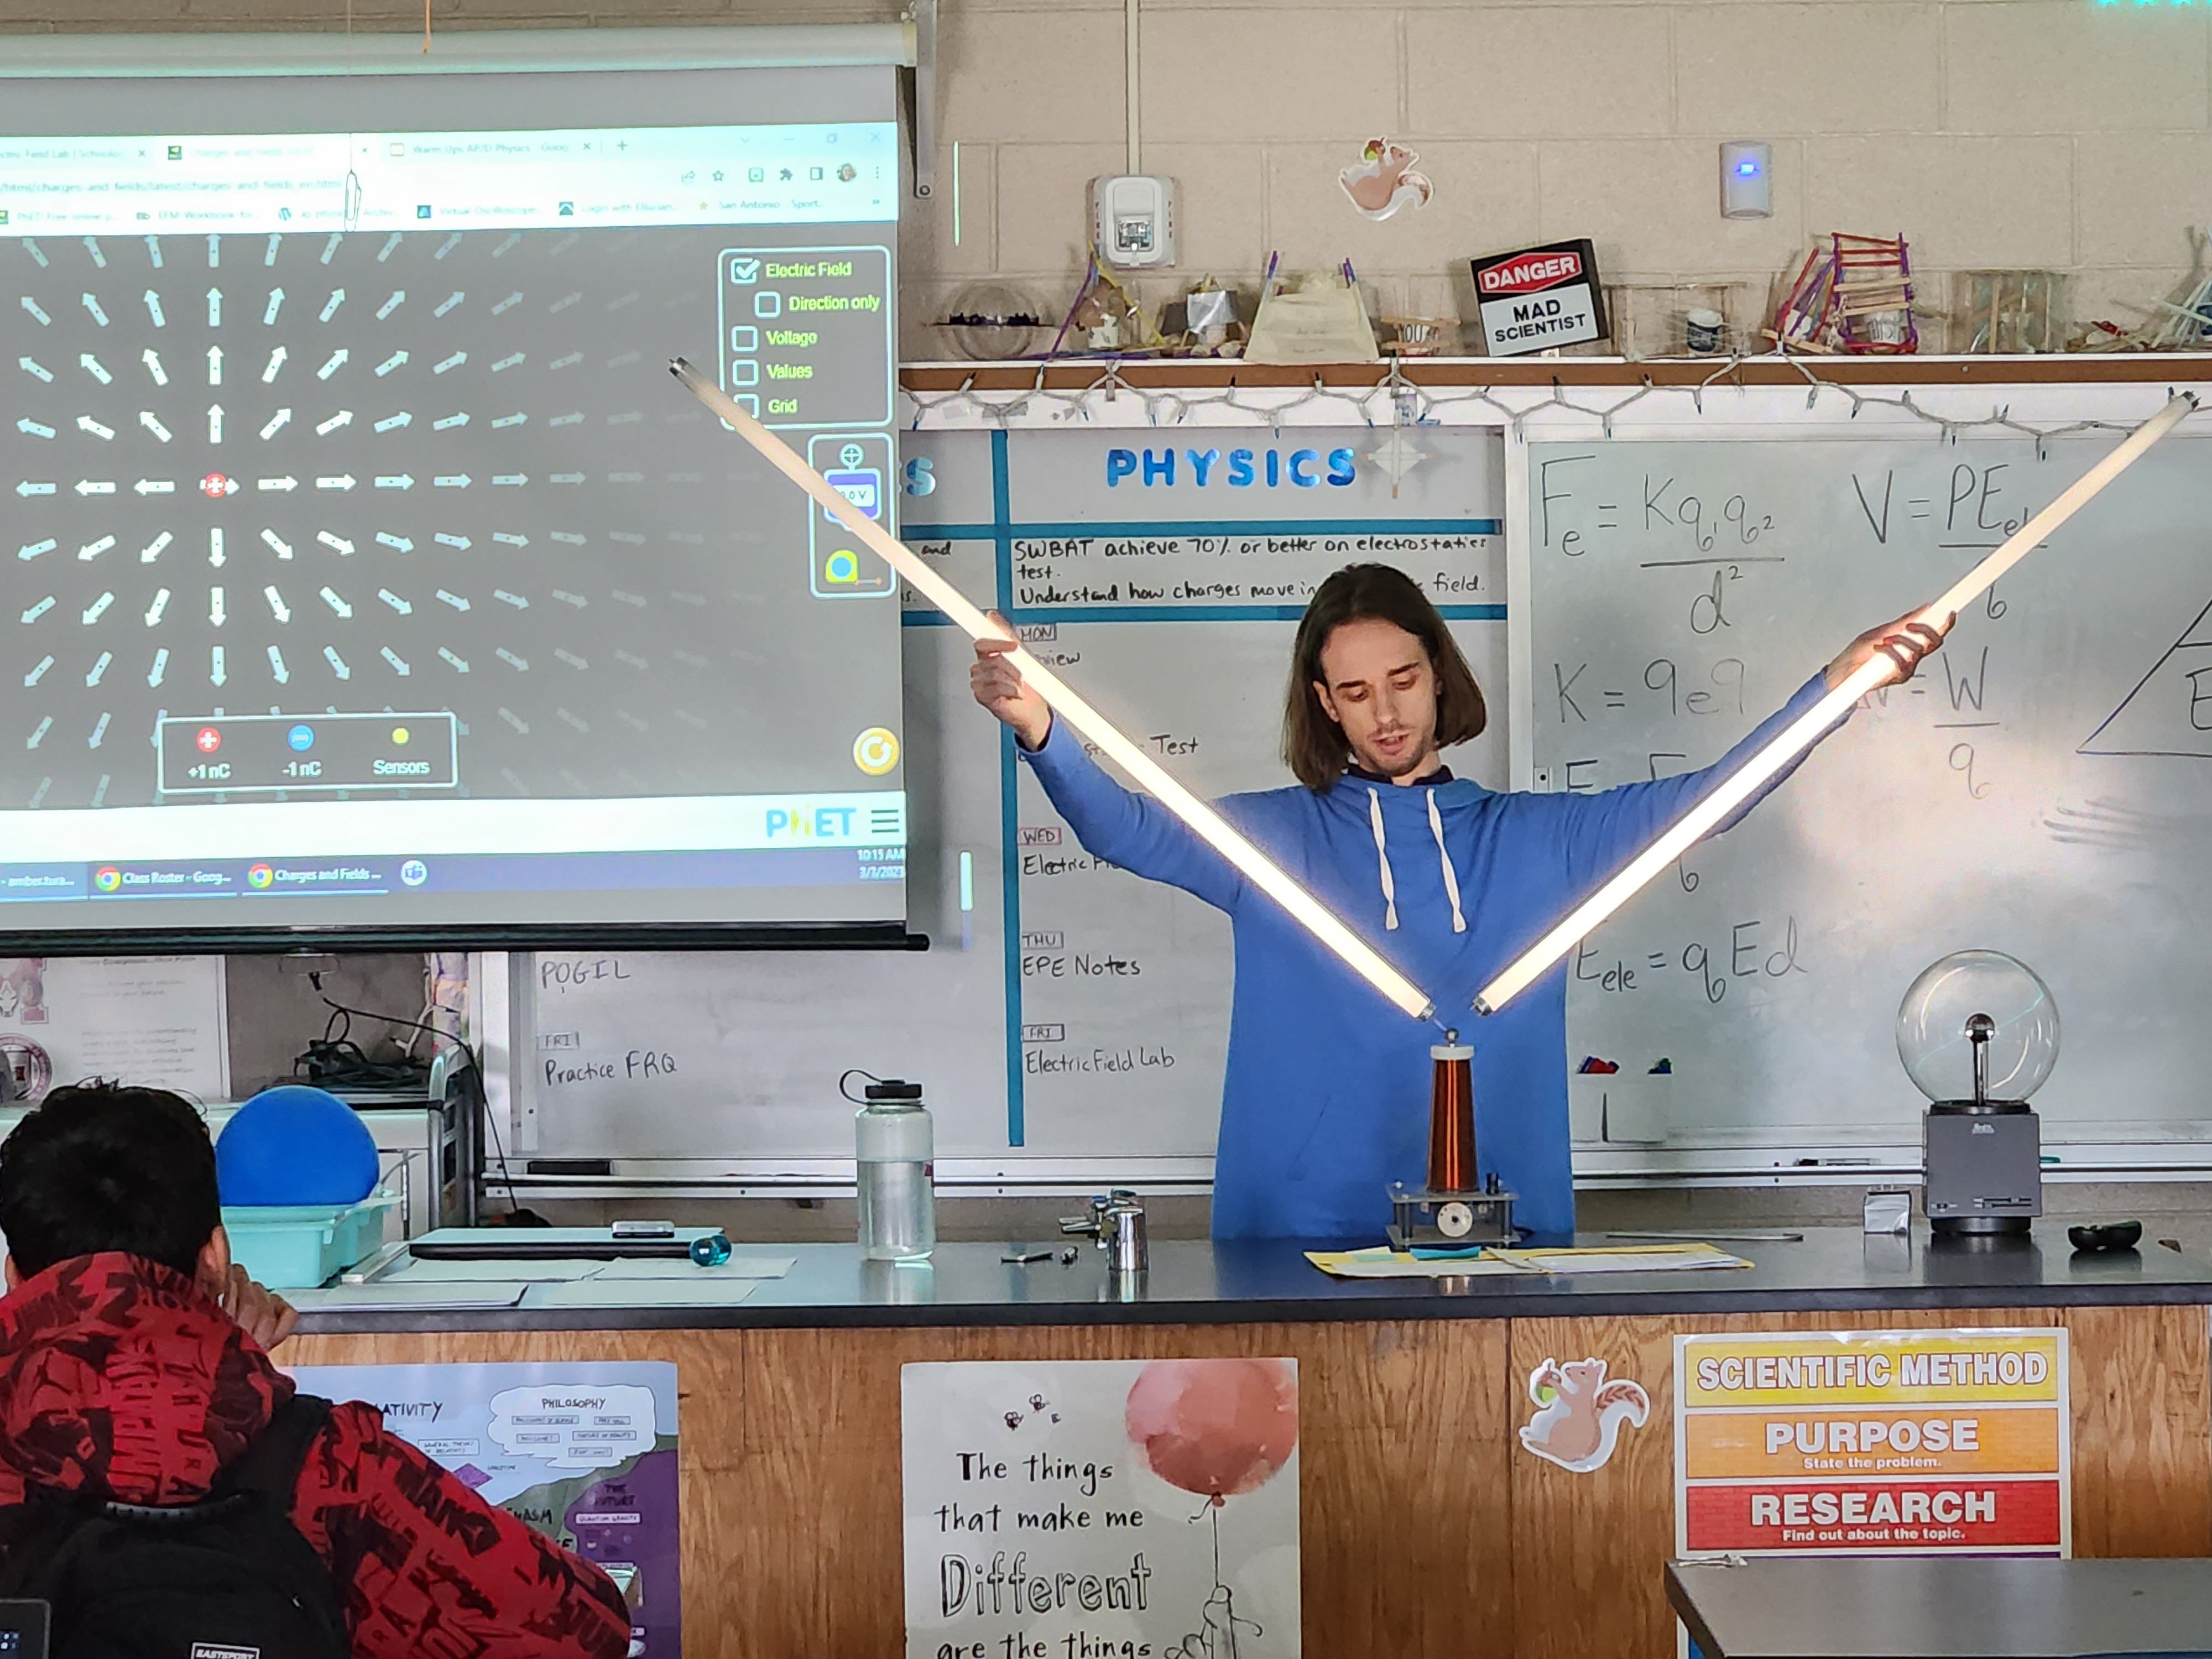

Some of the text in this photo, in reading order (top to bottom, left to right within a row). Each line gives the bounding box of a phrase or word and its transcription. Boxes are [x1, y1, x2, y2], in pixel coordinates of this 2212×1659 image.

[413, 146, 441, 156] Warm
[445, 145, 463, 157] Ups
[495, 144, 530, 158] Physics
[719, 200, 736, 209] San
[740, 199, 780, 209] Antonio
[765, 261, 853, 278] Electric Field
[1484, 256, 1576, 290] DANGER
[789, 294, 881, 312] Direction only
[1513, 299, 1561, 323] MAD
[1495, 313, 1586, 342] SCIENTIST
[766, 364, 814, 379] Values
[768, 399, 799, 414] Grid
[1107, 448, 1357, 487] PHYSICS
[1851, 469, 1893, 545] V
[921, 541, 952, 556] and
[1014, 539, 1095, 562] SWBAT
[1105, 539, 1181, 557] achieve
[1240, 541, 1262, 554] or
[1267, 537, 1318, 554] better
[1323, 539, 1350, 553] on
[1355, 535, 1488, 554] electrostatics
[1016, 563, 1062, 581] test.
[1432, 572, 1486, 593] field.
[1020, 580, 1317, 604] Understand how charges move in
[1021, 626, 1052, 641] MON
[1941, 645, 1990, 712] W
[1553, 662, 1588, 724] K
[1149, 734, 1199, 755] Test
[282, 760, 322, 777] -1 nC
[373, 759, 431, 775] Sensors
[1022, 828, 1056, 844] WED
[275, 867, 370, 884] Charges and Fields
[1023, 854, 1088, 876] Electric
[122, 872, 150, 884] Class
[152, 872, 184, 884] Roster
[1023, 934, 1057, 947] THU
[541, 959, 632, 990] POGIL
[1023, 953, 1141, 978] EPE Notes
[545, 1034, 572, 1048] FRI
[1029, 1027, 1052, 1040] FRI
[1025, 1045, 1176, 1076] Electric Field Lab
[545, 1058, 615, 1086] Practice
[1697, 1350, 2049, 1390] SCIENTIFIC METHOD
[541, 1397, 607, 1410] PHILOSOPHY
[1765, 1418, 1980, 1454] PURPOSE
[1803, 1455, 1942, 1470] State the problem.
[956, 1452, 1113, 1496] The things
[933, 1502, 1144, 1533] that make me
[1751, 1490, 1996, 1527] RESEARCH
[1782, 1526, 1966, 1542] Find out about the topic.
[941, 1551, 1152, 1618] Different
[936, 1631, 1152, 1659] are the things
